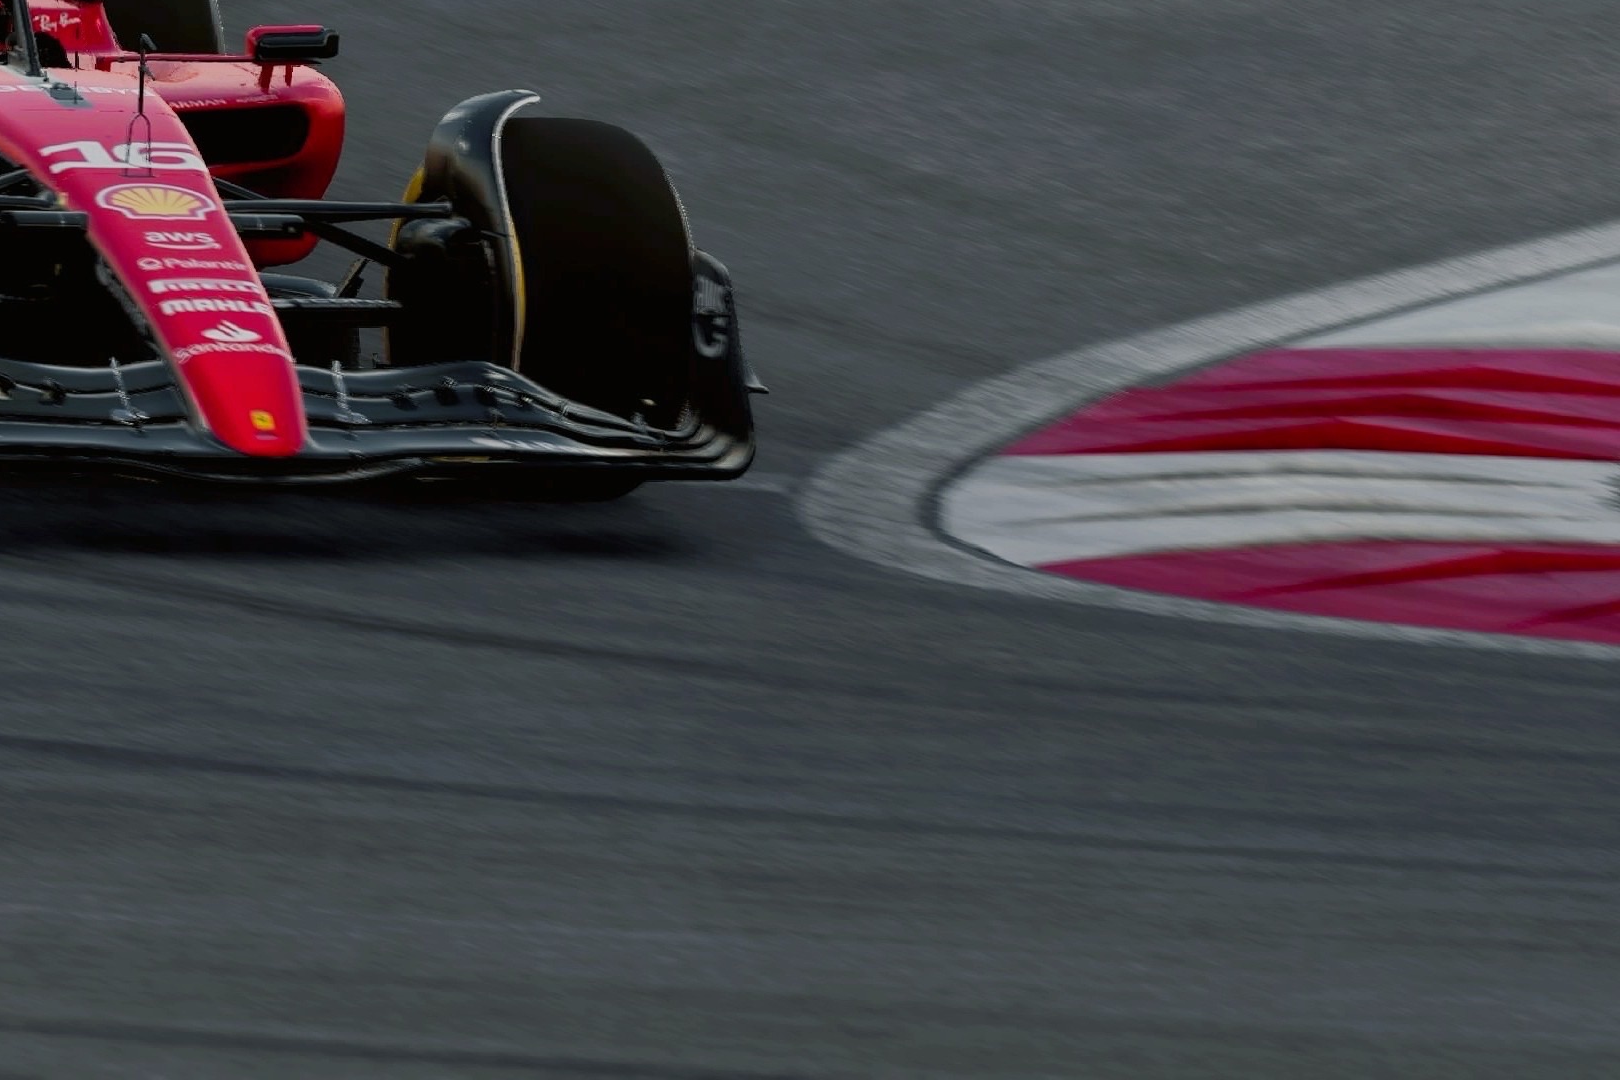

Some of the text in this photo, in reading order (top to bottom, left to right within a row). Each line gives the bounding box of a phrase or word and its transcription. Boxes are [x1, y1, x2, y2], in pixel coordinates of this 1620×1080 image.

[168, 99, 227, 110] ARMAN
[40, 141, 206, 174] 16
[144, 231, 216, 244] aws
[160, 298, 272, 316] MAHLE
